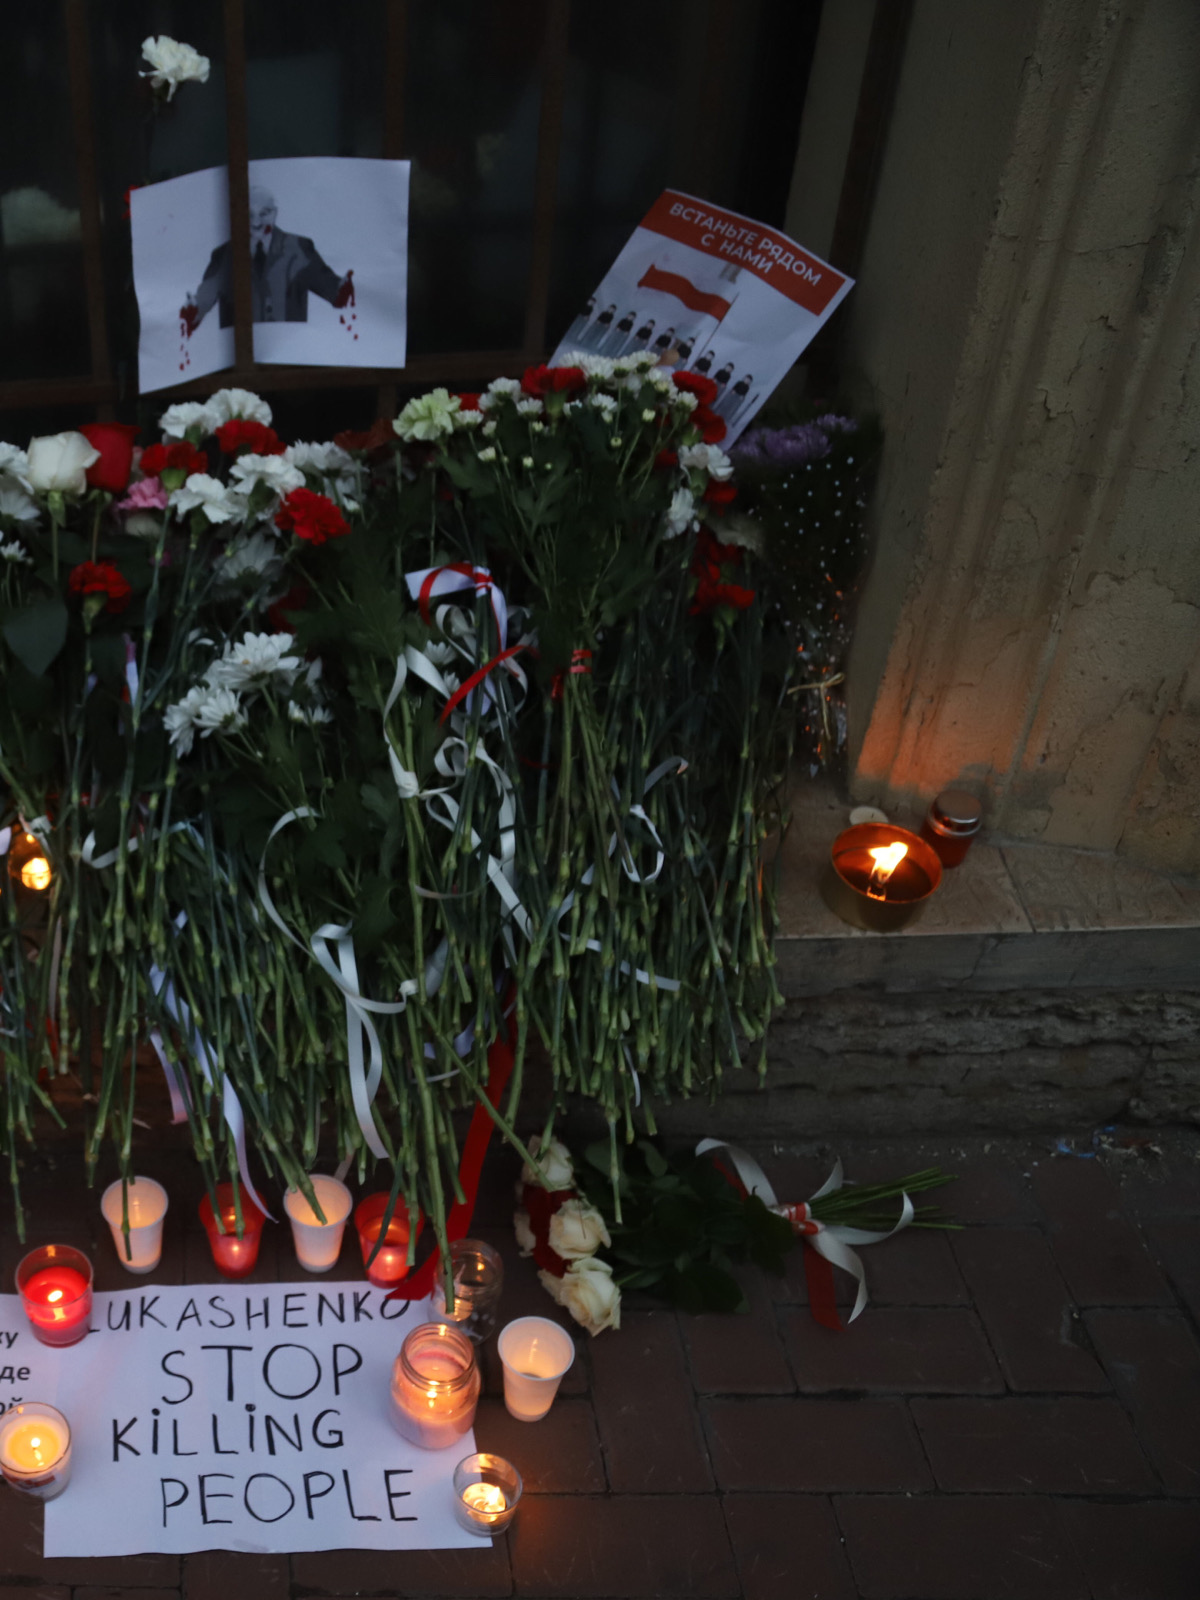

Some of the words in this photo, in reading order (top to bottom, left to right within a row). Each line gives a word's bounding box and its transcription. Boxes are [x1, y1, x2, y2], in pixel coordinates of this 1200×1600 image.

[669, 203, 758, 245] ВСТАНЬТЕ
[758, 237, 822, 286] РЯДОМ
[701, 234, 715, 246] С
[720, 240, 774, 274] НАМИ
[88, 1290, 411, 1333] UKASHENKO
[160, 1343, 363, 1405] STOP
[160, 1469, 418, 1528] PEOPLE
